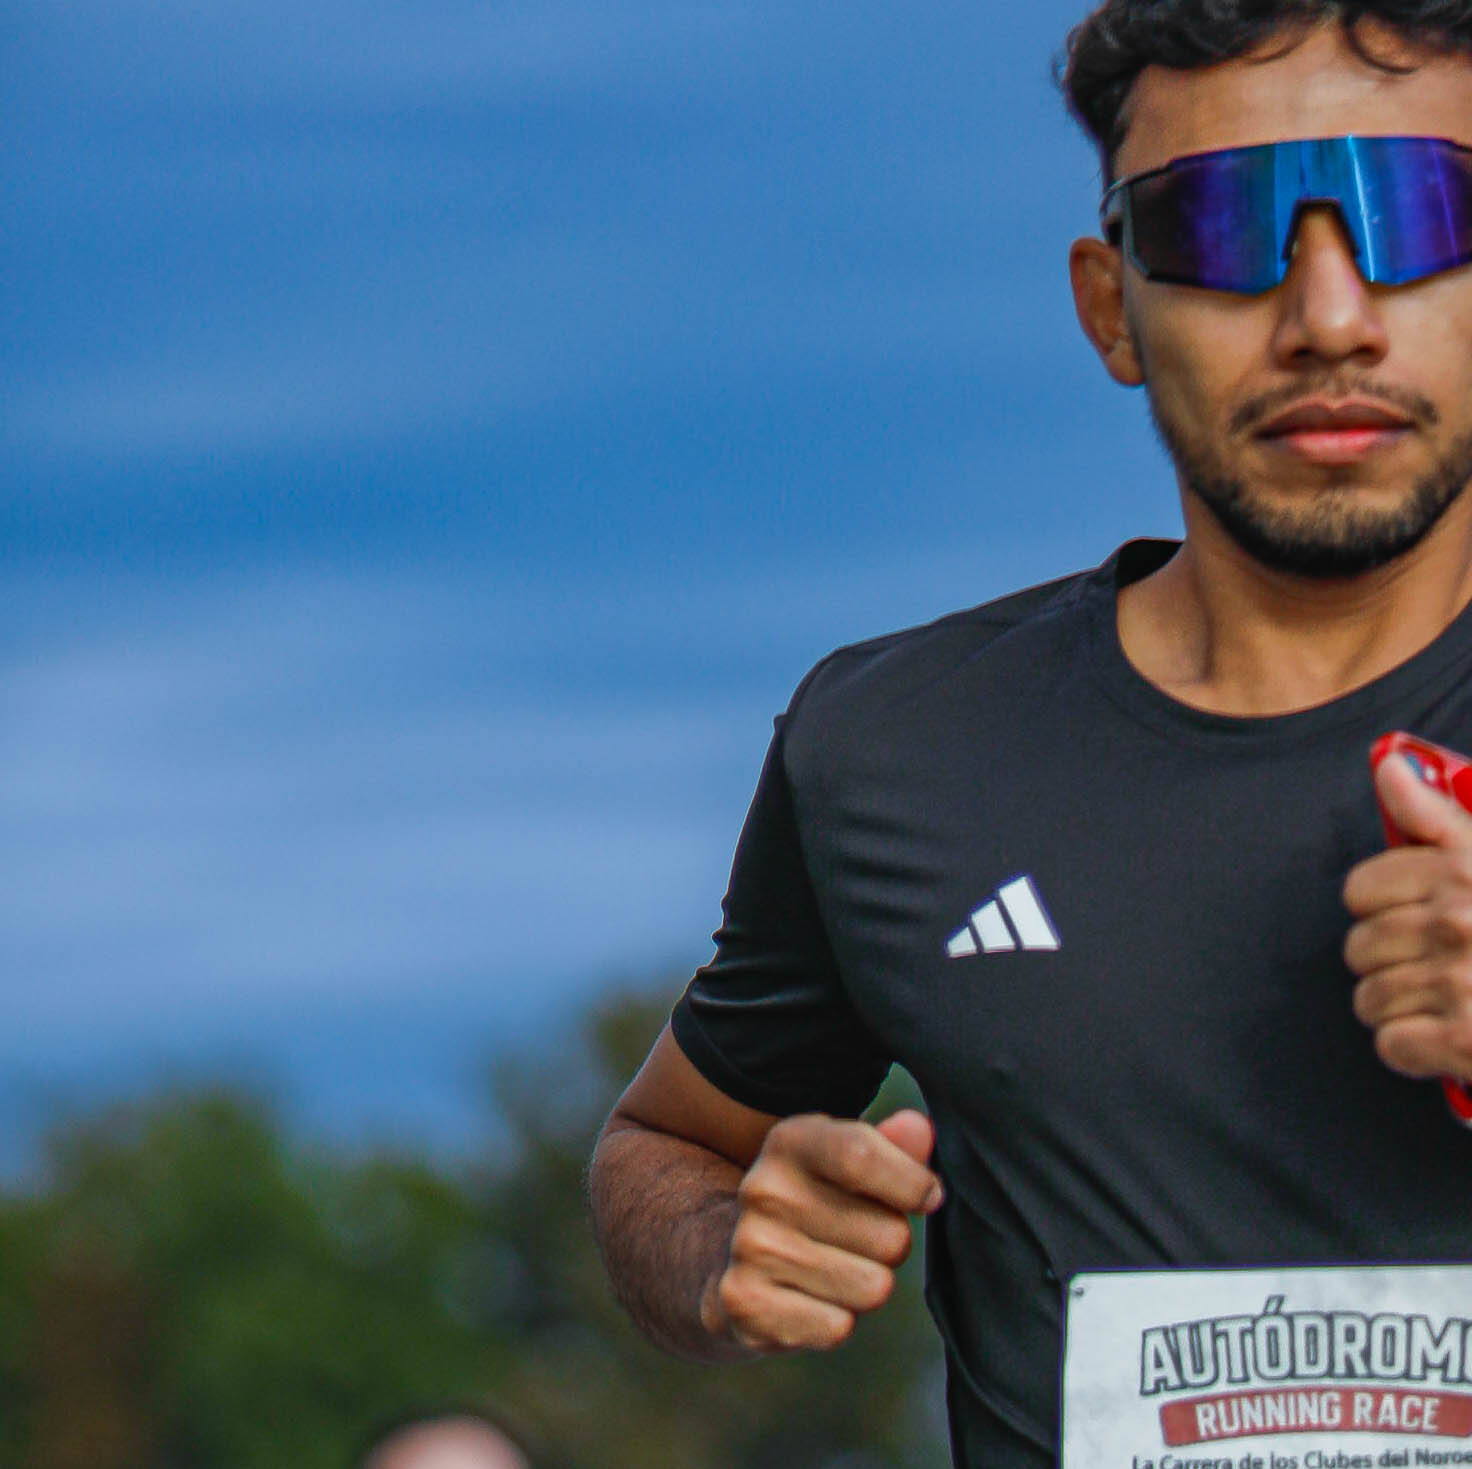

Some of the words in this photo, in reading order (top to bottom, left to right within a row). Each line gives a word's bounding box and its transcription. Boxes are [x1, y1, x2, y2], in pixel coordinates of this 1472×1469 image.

[1195, 1392, 1342, 1437] RUNNING
[1353, 1392, 1440, 1431] RACE
[1304, 1449, 1372, 1469] Clubes
[1378, 1448, 1409, 1467] del
